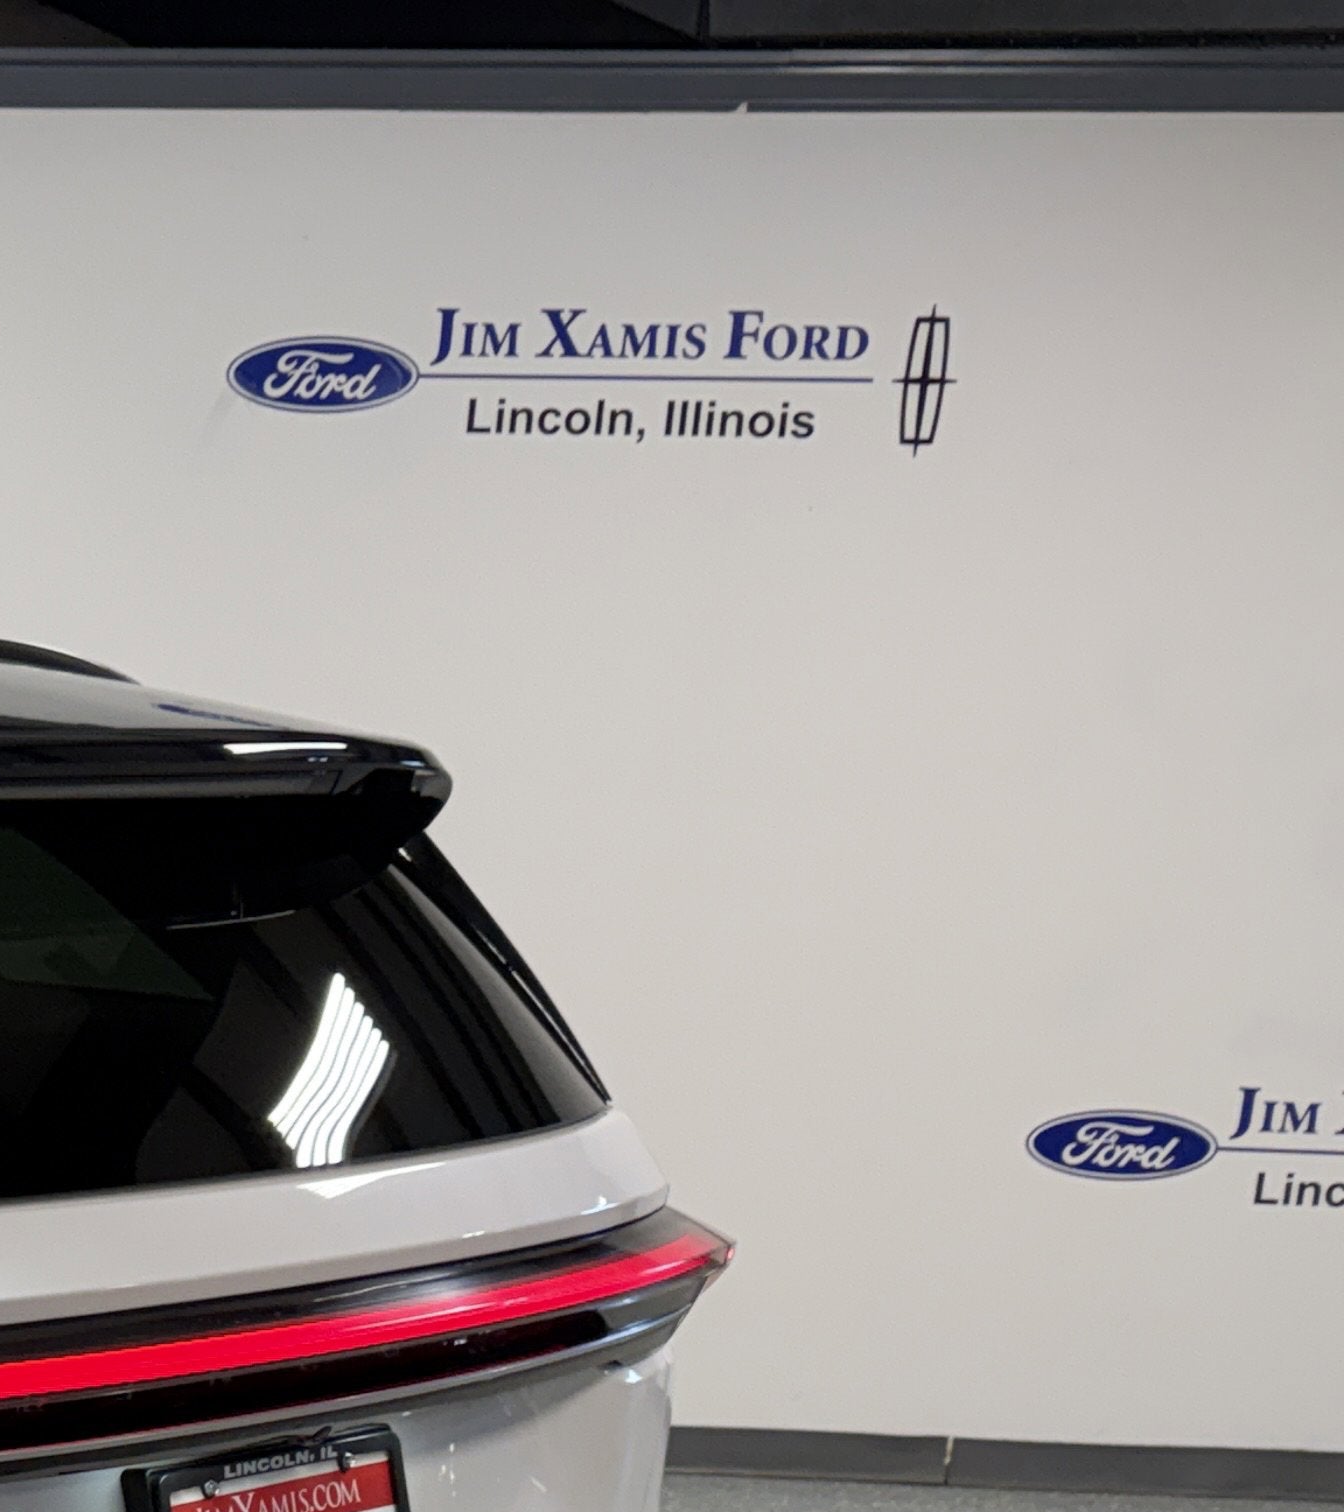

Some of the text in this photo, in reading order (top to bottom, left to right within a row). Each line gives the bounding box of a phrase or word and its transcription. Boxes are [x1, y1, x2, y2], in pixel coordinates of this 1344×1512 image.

[430, 308, 869, 366] JIM XAMIS FORD
[263, 347, 380, 402] Ford
[466, 398, 815, 442] Lincoln, Illinois
[1229, 1086, 1322, 1140] JIM
[1062, 1120, 1181, 1170] Ford
[320, 1446, 338, 1460] IL
